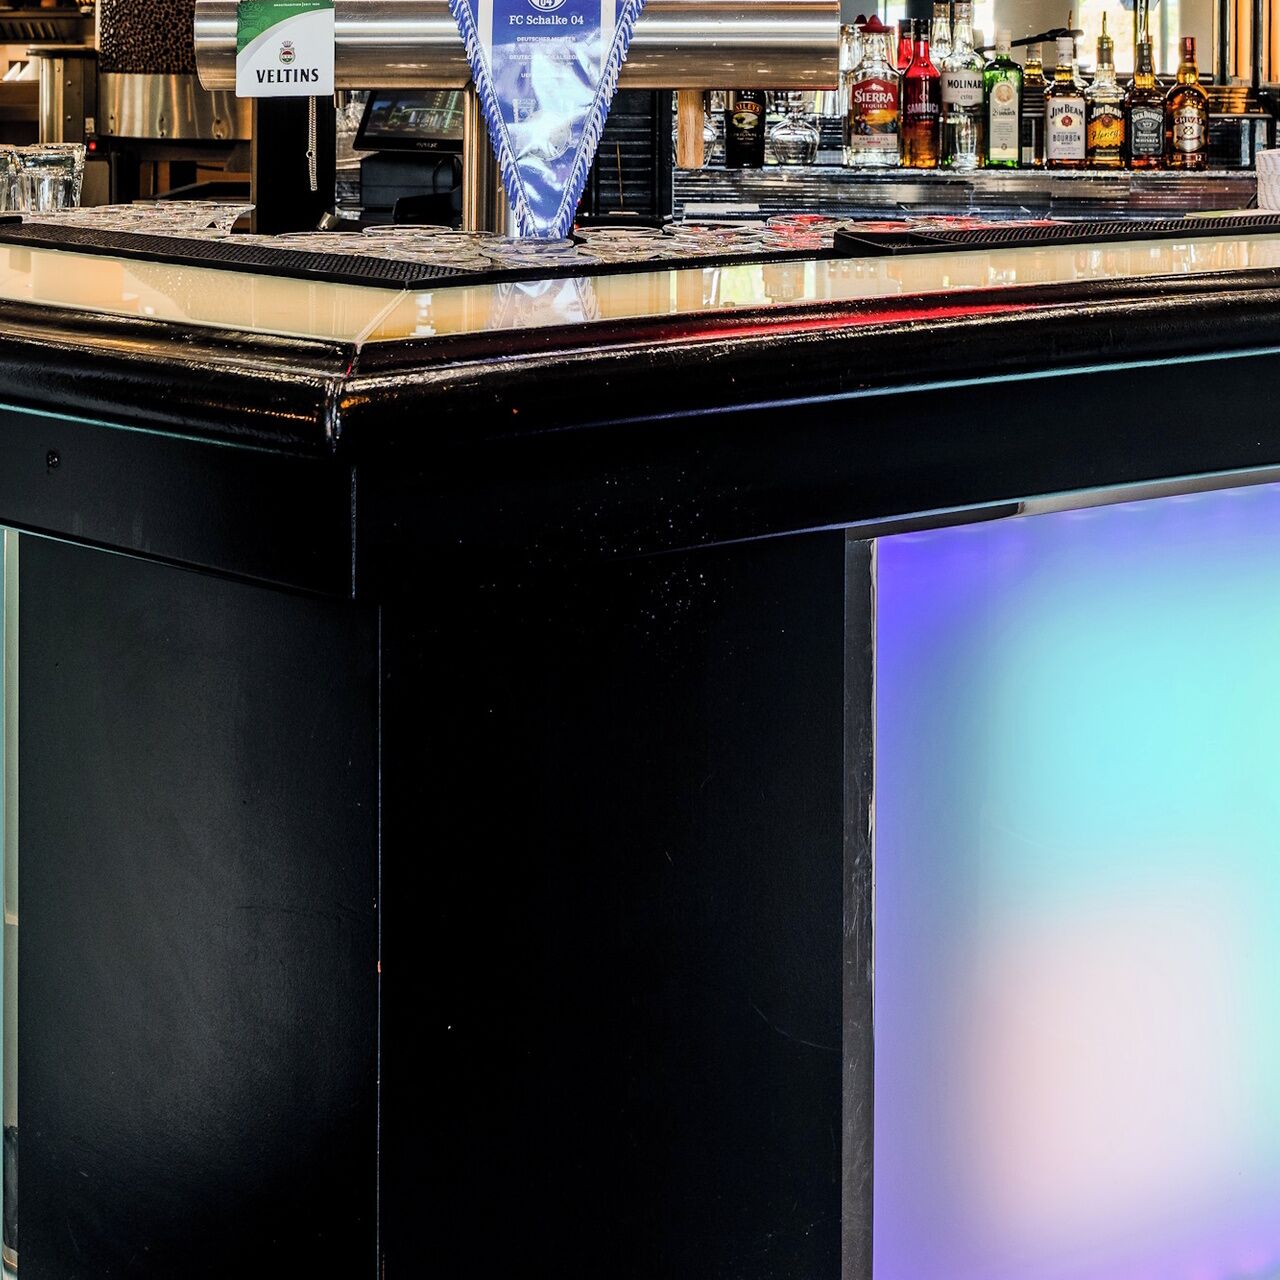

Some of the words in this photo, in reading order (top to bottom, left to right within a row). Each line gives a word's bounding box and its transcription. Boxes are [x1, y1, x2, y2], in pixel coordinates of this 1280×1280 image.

[509, 15, 524, 25] FC
[526, 15, 568, 25] Schalke
[571, 15, 584, 25] 04
[256, 68, 319, 84] VELTINS
[947, 79, 983, 89] MOLINAR
[854, 89, 894, 103] SIERRA
[735, 103, 760, 113] AILEYS
[1050, 106, 1064, 119] JIM
[1064, 104, 1083, 119] BEAM
[1053, 134, 1081, 142] BOURBON
